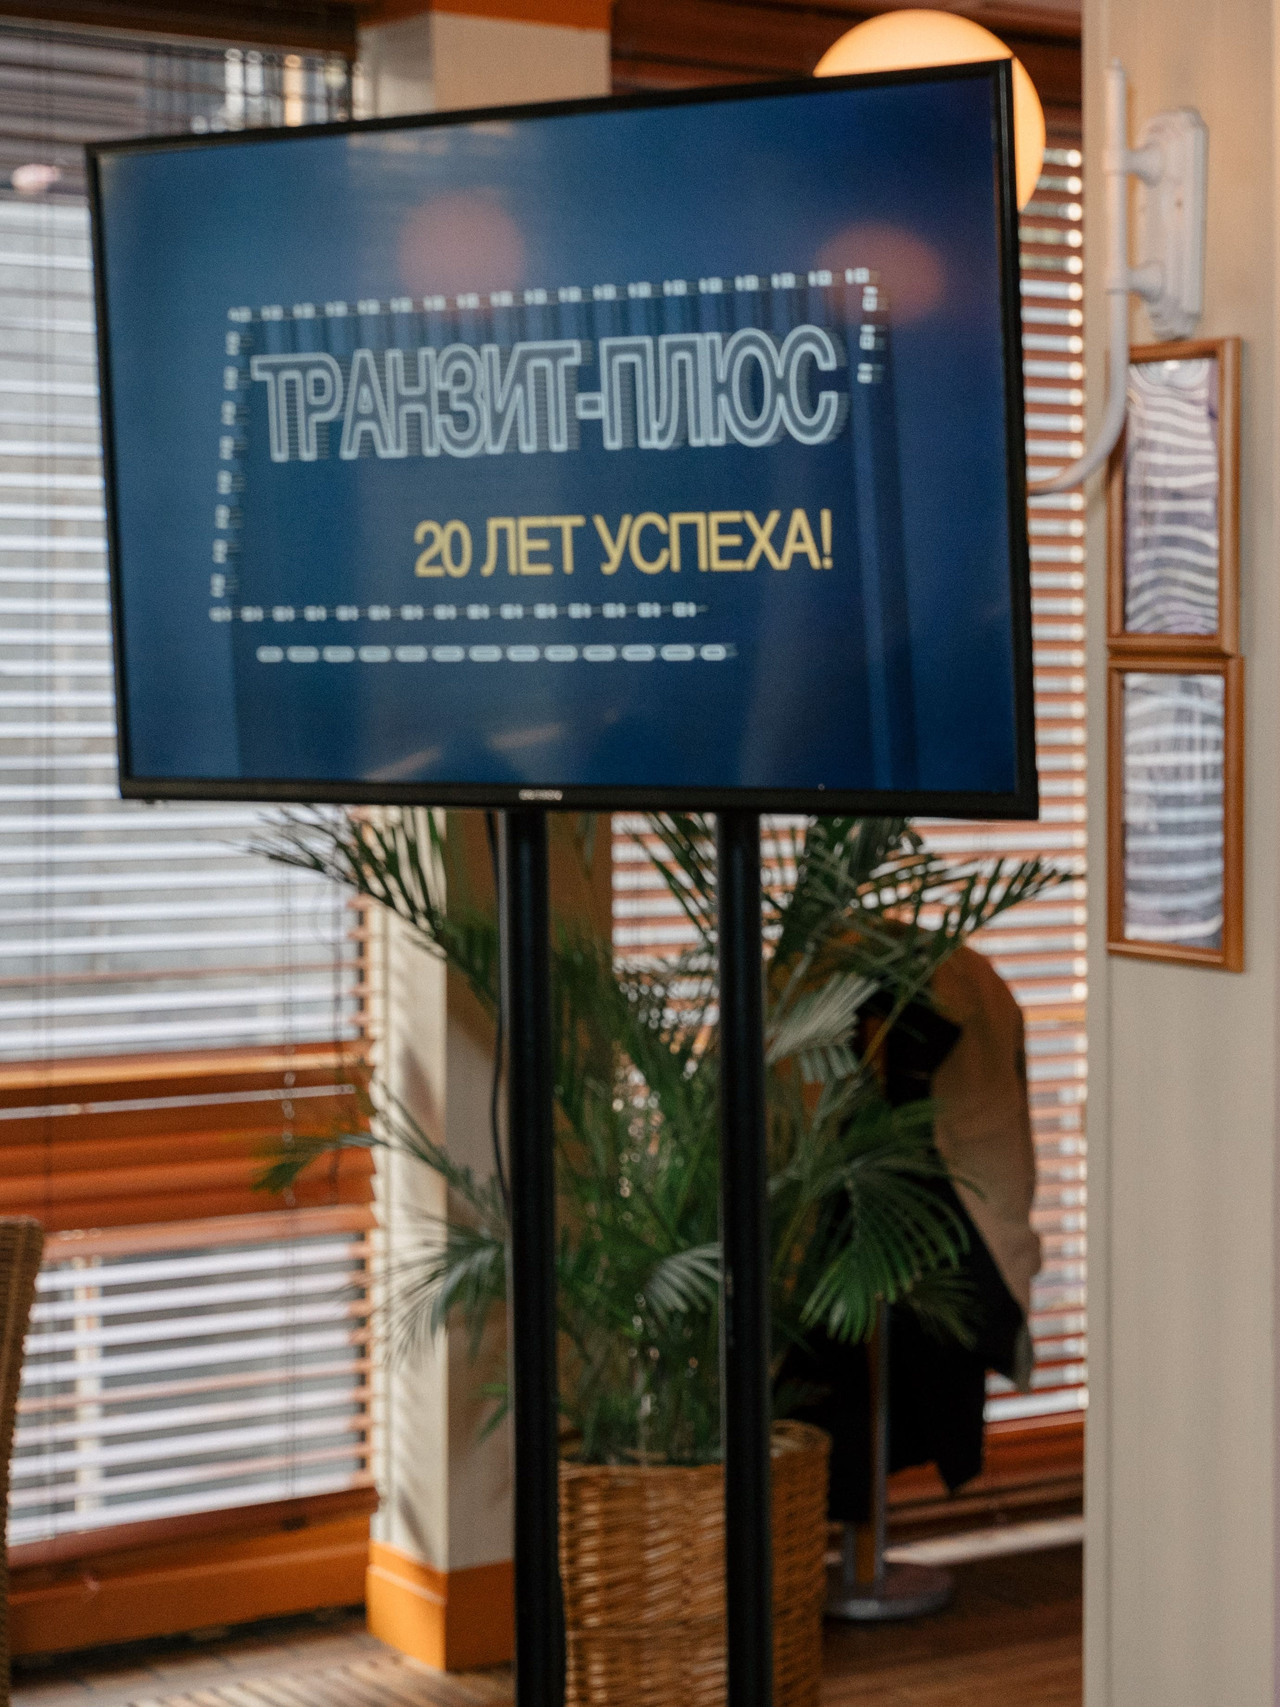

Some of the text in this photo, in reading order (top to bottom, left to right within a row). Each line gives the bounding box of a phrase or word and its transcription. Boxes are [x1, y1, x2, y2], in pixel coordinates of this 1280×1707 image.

[251, 325, 842, 462] ТРАНЗИТ-ПЛЮС
[414, 509, 834, 577] 20 ЛЕТ УСПЕХА!
